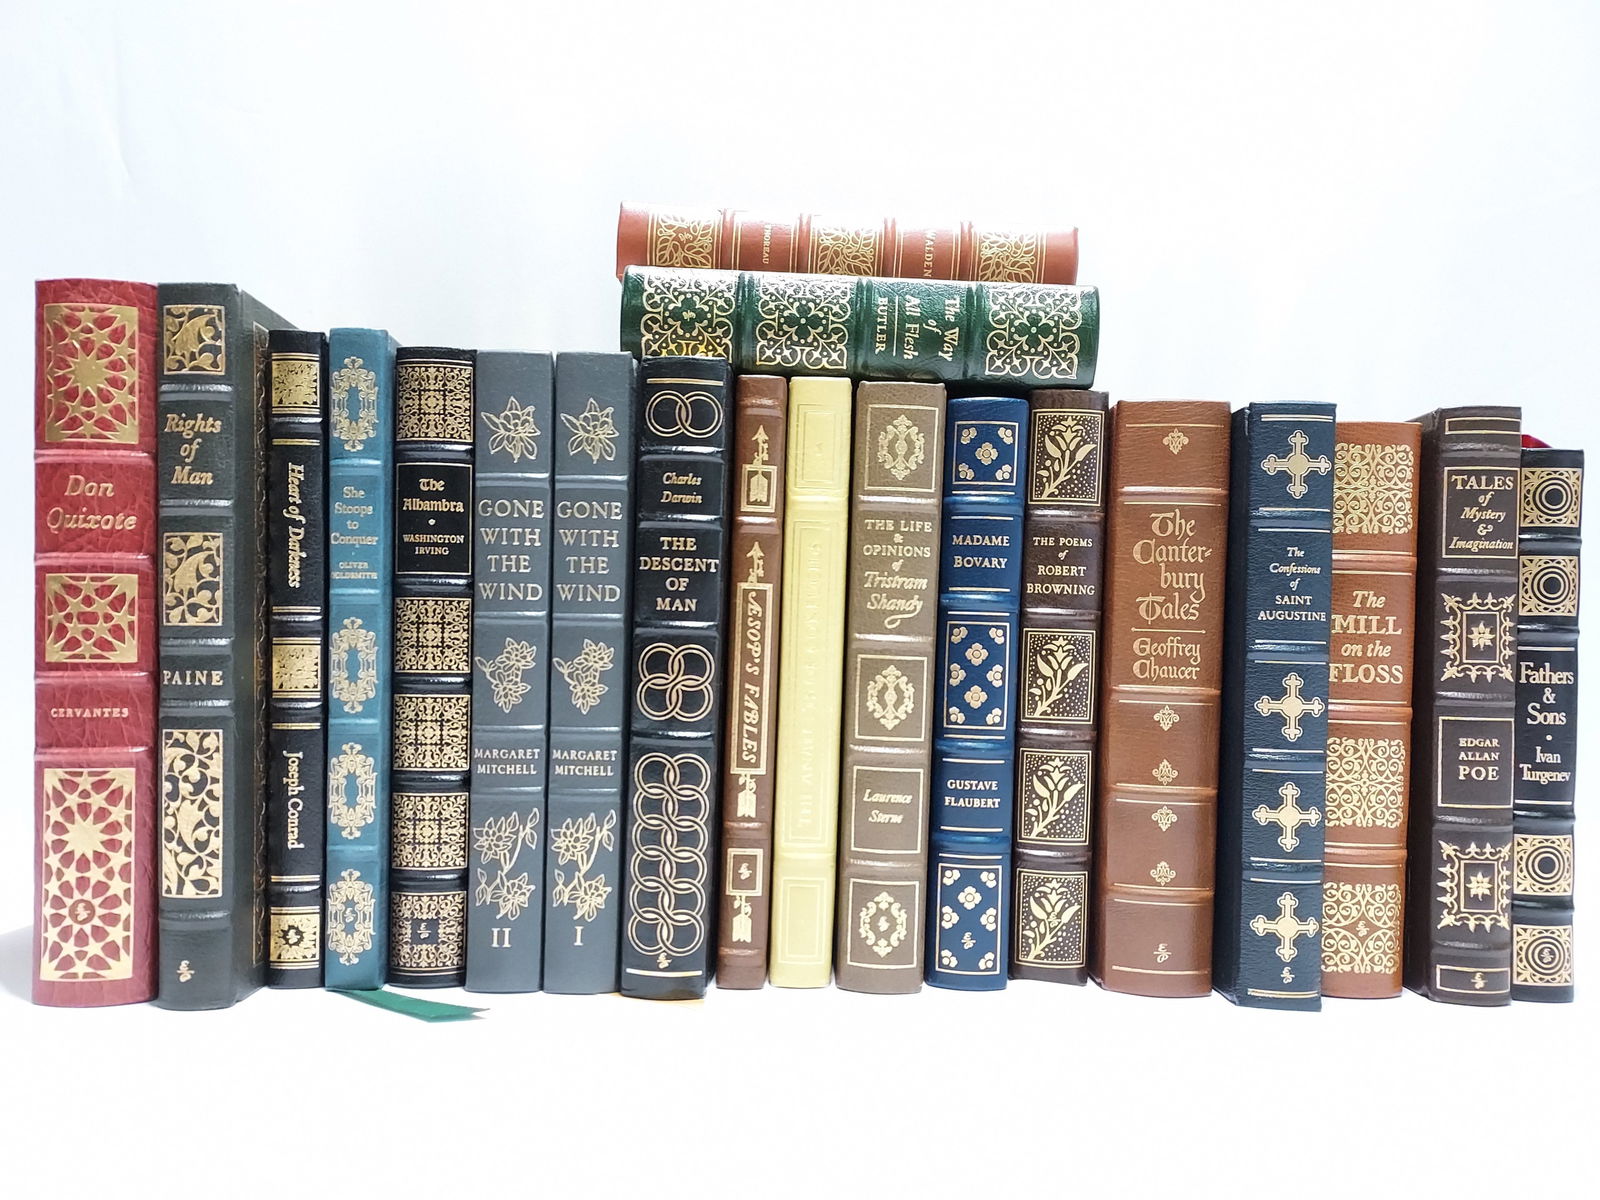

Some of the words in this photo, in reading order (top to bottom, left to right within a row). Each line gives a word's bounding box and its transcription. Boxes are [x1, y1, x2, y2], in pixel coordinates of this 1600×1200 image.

[923, 229, 937, 278] WALDEN
[905, 295, 921, 316] All
[945, 296, 960, 322] The
[875, 297, 888, 355] BUTLER
[923, 319, 942, 336] of
[903, 323, 920, 360] Flesh
[938, 327, 960, 361] Way
[165, 413, 221, 436] Rights
[180, 438, 199, 462] of
[171, 466, 213, 485] Man
[288, 462, 304, 504] Heart
[663, 472, 702, 486] Charles
[1451, 475, 1514, 490] TALES
[64, 475, 114, 497] Don
[343, 486, 365, 498] She
[419, 479, 445, 491] The
[403, 498, 464, 513] Alhambra
[660, 491, 702, 504] Darwin
[1478, 491, 1495, 506] of
[282, 505, 306, 524] of
[335, 502, 373, 517] Stoops
[478, 500, 545, 519] GONE
[557, 501, 623, 520] GONE
[1461, 507, 1506, 522] Mystery
[46, 507, 137, 533] Quixote
[346, 520, 359, 529] to
[864, 519, 894, 532] THE
[900, 520, 933, 533] LIFE
[1150, 508, 1196, 540] The
[480, 528, 541, 546] WITH
[559, 529, 620, 547] WITH
[1477, 524, 1493, 536] &
[331, 533, 378, 548] Conquer
[403, 534, 464, 544] WASHINGTON
[660, 537, 697, 550] THE
[952, 535, 1010, 546] MADAME
[1032, 537, 1055, 546] THE
[1059, 538, 1093, 547] POEMS
[1449, 536, 1514, 552] Imagination
[288, 525, 307, 589] Darkness
[415, 547, 449, 555] IRVING
[863, 545, 931, 557] OPINIONS
[1058, 550, 1068, 560] of
[1286, 547, 1304, 558] The
[339, 561, 368, 569] OLIVER
[487, 555, 532, 573] THE
[566, 556, 609, 574] THE
[639, 557, 719, 573] DESCENT
[892, 559, 904, 572] of
[954, 556, 1008, 569] BOVARY
[1269, 563, 1321, 575] Confessions
[1037, 565, 1087, 577] ROBERT
[665, 577, 689, 591] OF
[864, 571, 928, 590] Tristram
[1159, 562, 1206, 603] bury
[1289, 578, 1300, 590] of
[478, 583, 543, 601] WIND
[557, 584, 621, 602] WIND
[1026, 583, 1096, 596] BROWNING
[656, 598, 698, 612] MAN
[1275, 595, 1312, 605] SAINT
[1352, 591, 1386, 608] The
[867, 593, 923, 629] Shandy
[1135, 592, 1200, 625] Tales
[1257, 611, 1326, 622] AUGUSTINE
[1331, 614, 1402, 635] MILL
[1132, 636, 1201, 664] Geoffrey
[1341, 643, 1363, 657] on
[1366, 641, 1391, 657] the
[1132, 657, 1200, 682] Chaucer
[1329, 663, 1403, 684] FLOSS
[1519, 662, 1574, 684] Fathers
[163, 670, 223, 686] PAINE
[1542, 687, 1556, 704] &
[50, 707, 129, 718] CERVANTES
[1527, 702, 1567, 725] Sons
[742, 682, 760, 763] FABLES
[1458, 738, 1500, 748] EDGAR
[474, 748, 540, 759] MARGARET
[552, 749, 618, 761] MARGARET
[1458, 752, 1500, 761] ALLAN
[1535, 746, 1561, 763] Ivan
[283, 750, 305, 796] Joseph
[477, 765, 537, 775] MITCHELL
[554, 766, 614, 777] MITCHELL
[1458, 765, 1500, 781] POE
[1519, 764, 1571, 785] Turgenev
[947, 780, 998, 791] GUSTAVE
[863, 789, 913, 804] Laurence
[944, 797, 1000, 808] FLAUBERT
[287, 798, 305, 850] Conrad
[868, 810, 904, 824] Sterne
[491, 928, 512, 948] II
[574, 926, 584, 946] I
